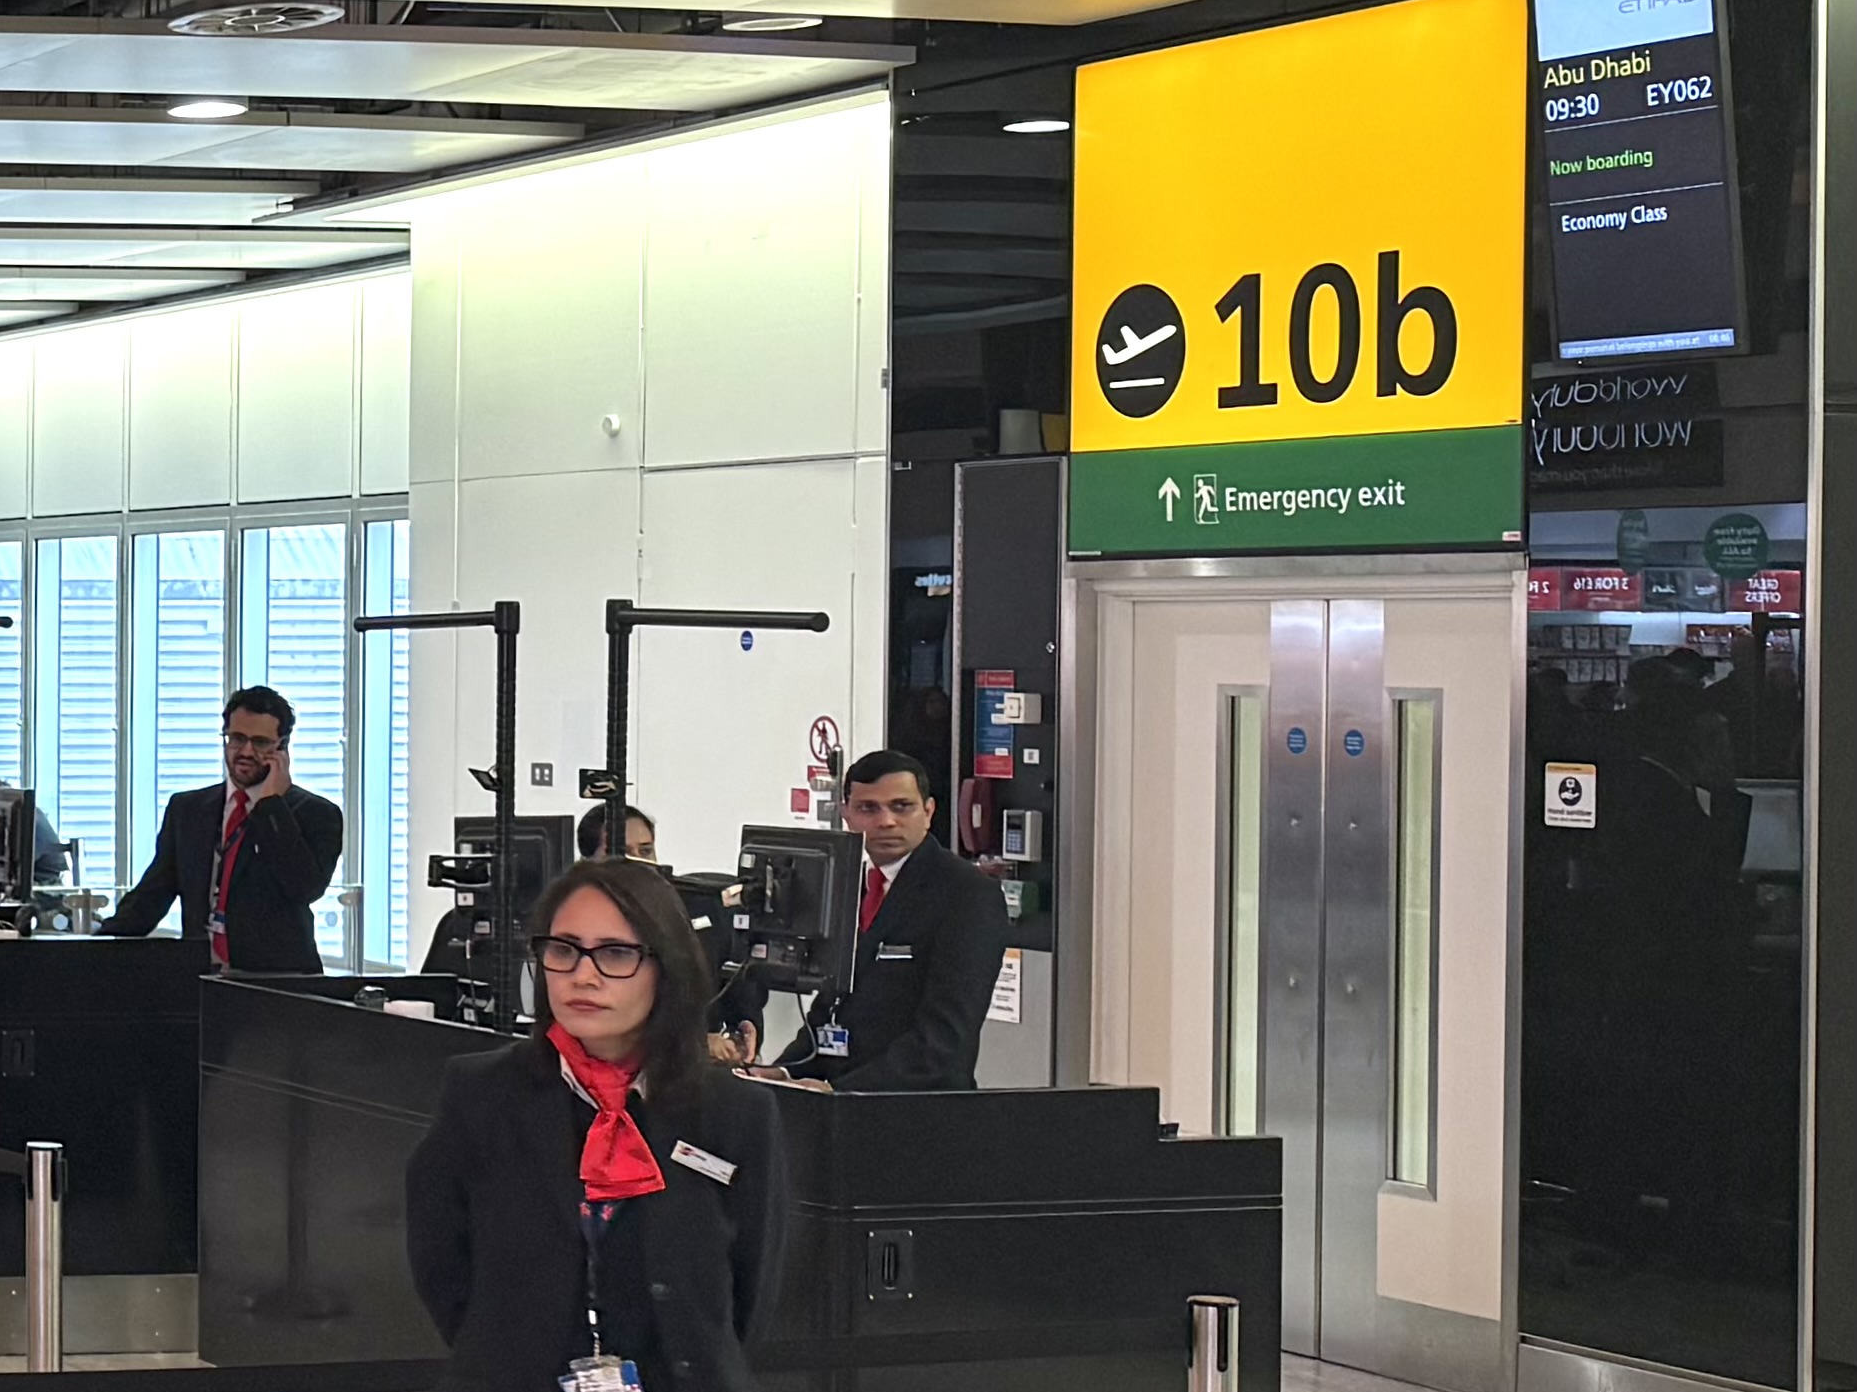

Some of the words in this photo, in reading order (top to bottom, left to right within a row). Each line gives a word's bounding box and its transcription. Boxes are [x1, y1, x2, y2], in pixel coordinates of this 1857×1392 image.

[1543, 63, 1584, 89] Abu
[1590, 49, 1651, 81] Dhabi
[1545, 93, 1600, 121] 09:30
[1646, 75, 1713, 107] EY062
[1549, 159, 1583, 176] Now
[1586, 149, 1654, 172] boarding
[1561, 210, 1627, 232] Economy
[1630, 205, 1668, 224] Class
[1214, 249, 1458, 410] 10b
[1224, 486, 1353, 516] Emergency
[1358, 479, 1406, 507] exit
